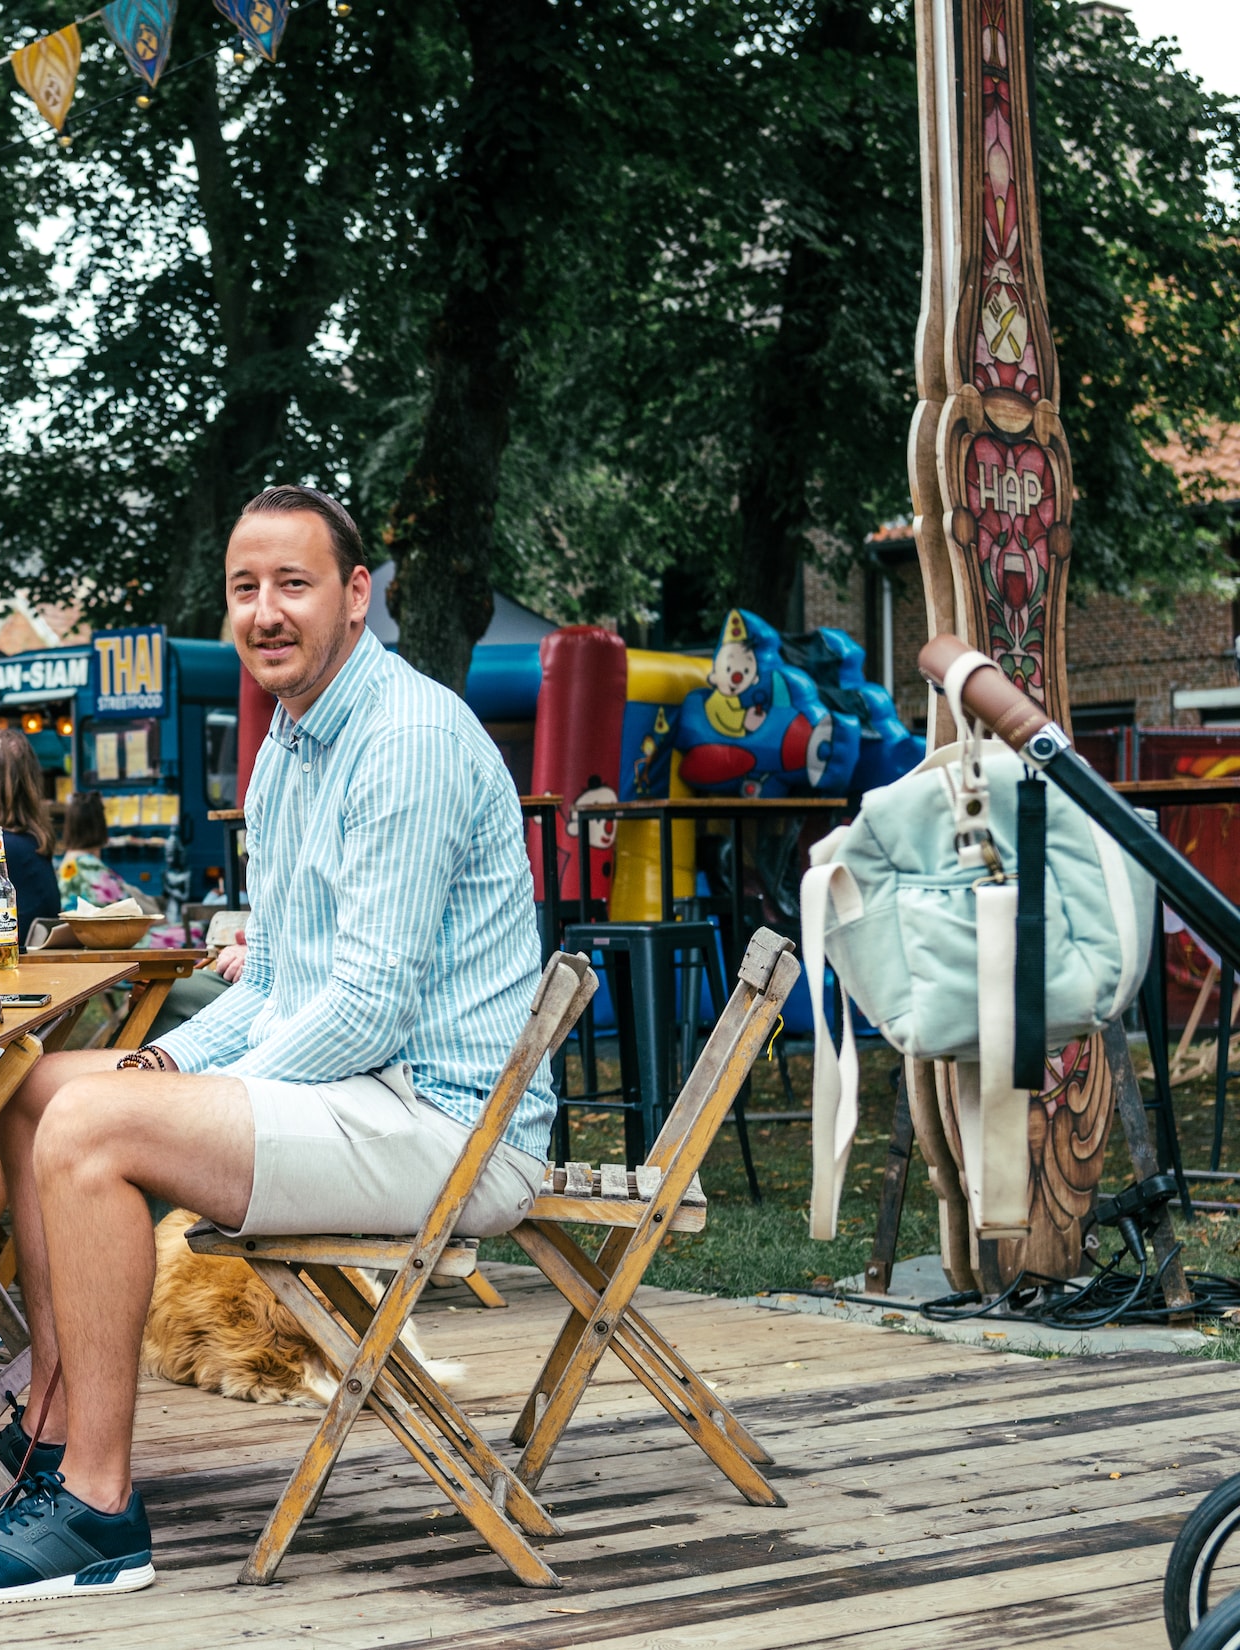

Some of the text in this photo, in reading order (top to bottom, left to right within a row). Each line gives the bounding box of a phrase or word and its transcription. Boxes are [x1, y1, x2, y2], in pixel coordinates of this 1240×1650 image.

[978, 461, 1042, 516] HAP
[94, 632, 163, 695] THAI
[97, 693, 164, 711] STREETFOOD
[23, 1524, 49, 1543] BORG
